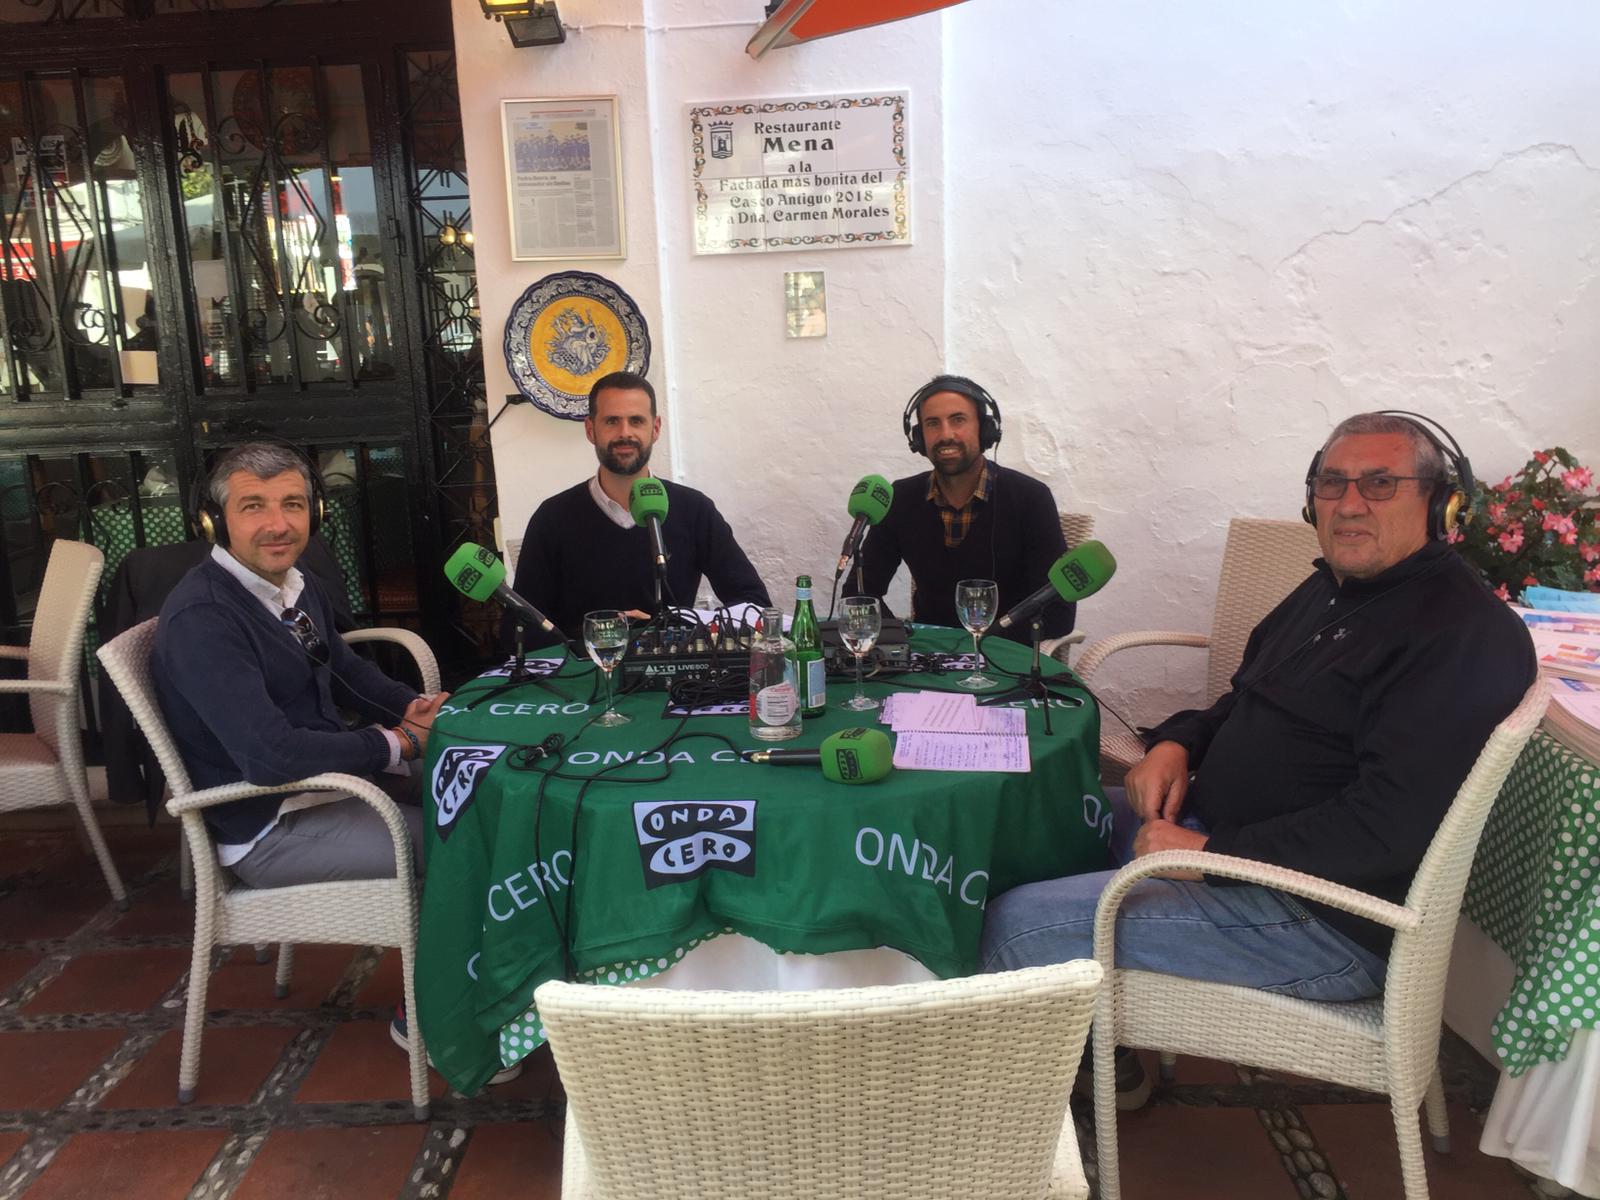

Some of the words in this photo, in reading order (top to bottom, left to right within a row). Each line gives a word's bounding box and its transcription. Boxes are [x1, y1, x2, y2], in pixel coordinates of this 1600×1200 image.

[754, 120, 841, 135] Restaurante
[763, 137, 834, 153] Mena
[788, 164, 795, 173] a
[800, 161, 812, 173] la
[720, 177, 778, 191] Fachada
[815, 173, 858, 187] bonita
[862, 171, 883, 184] del
[730, 195, 774, 208] Casco
[778, 193, 832, 207] Antiguo
[836, 190, 873, 203] 2018
[773, 208, 828, 222] Carmen
[832, 206, 890, 220] Morales
[489, 703, 590, 715] CERO
[567, 751, 696, 765] ONDA
[650, 807, 736, 831] ONDA
[663, 838, 736, 867] CERO
[855, 827, 954, 895] ONDA
[488, 850, 574, 922] CERO
